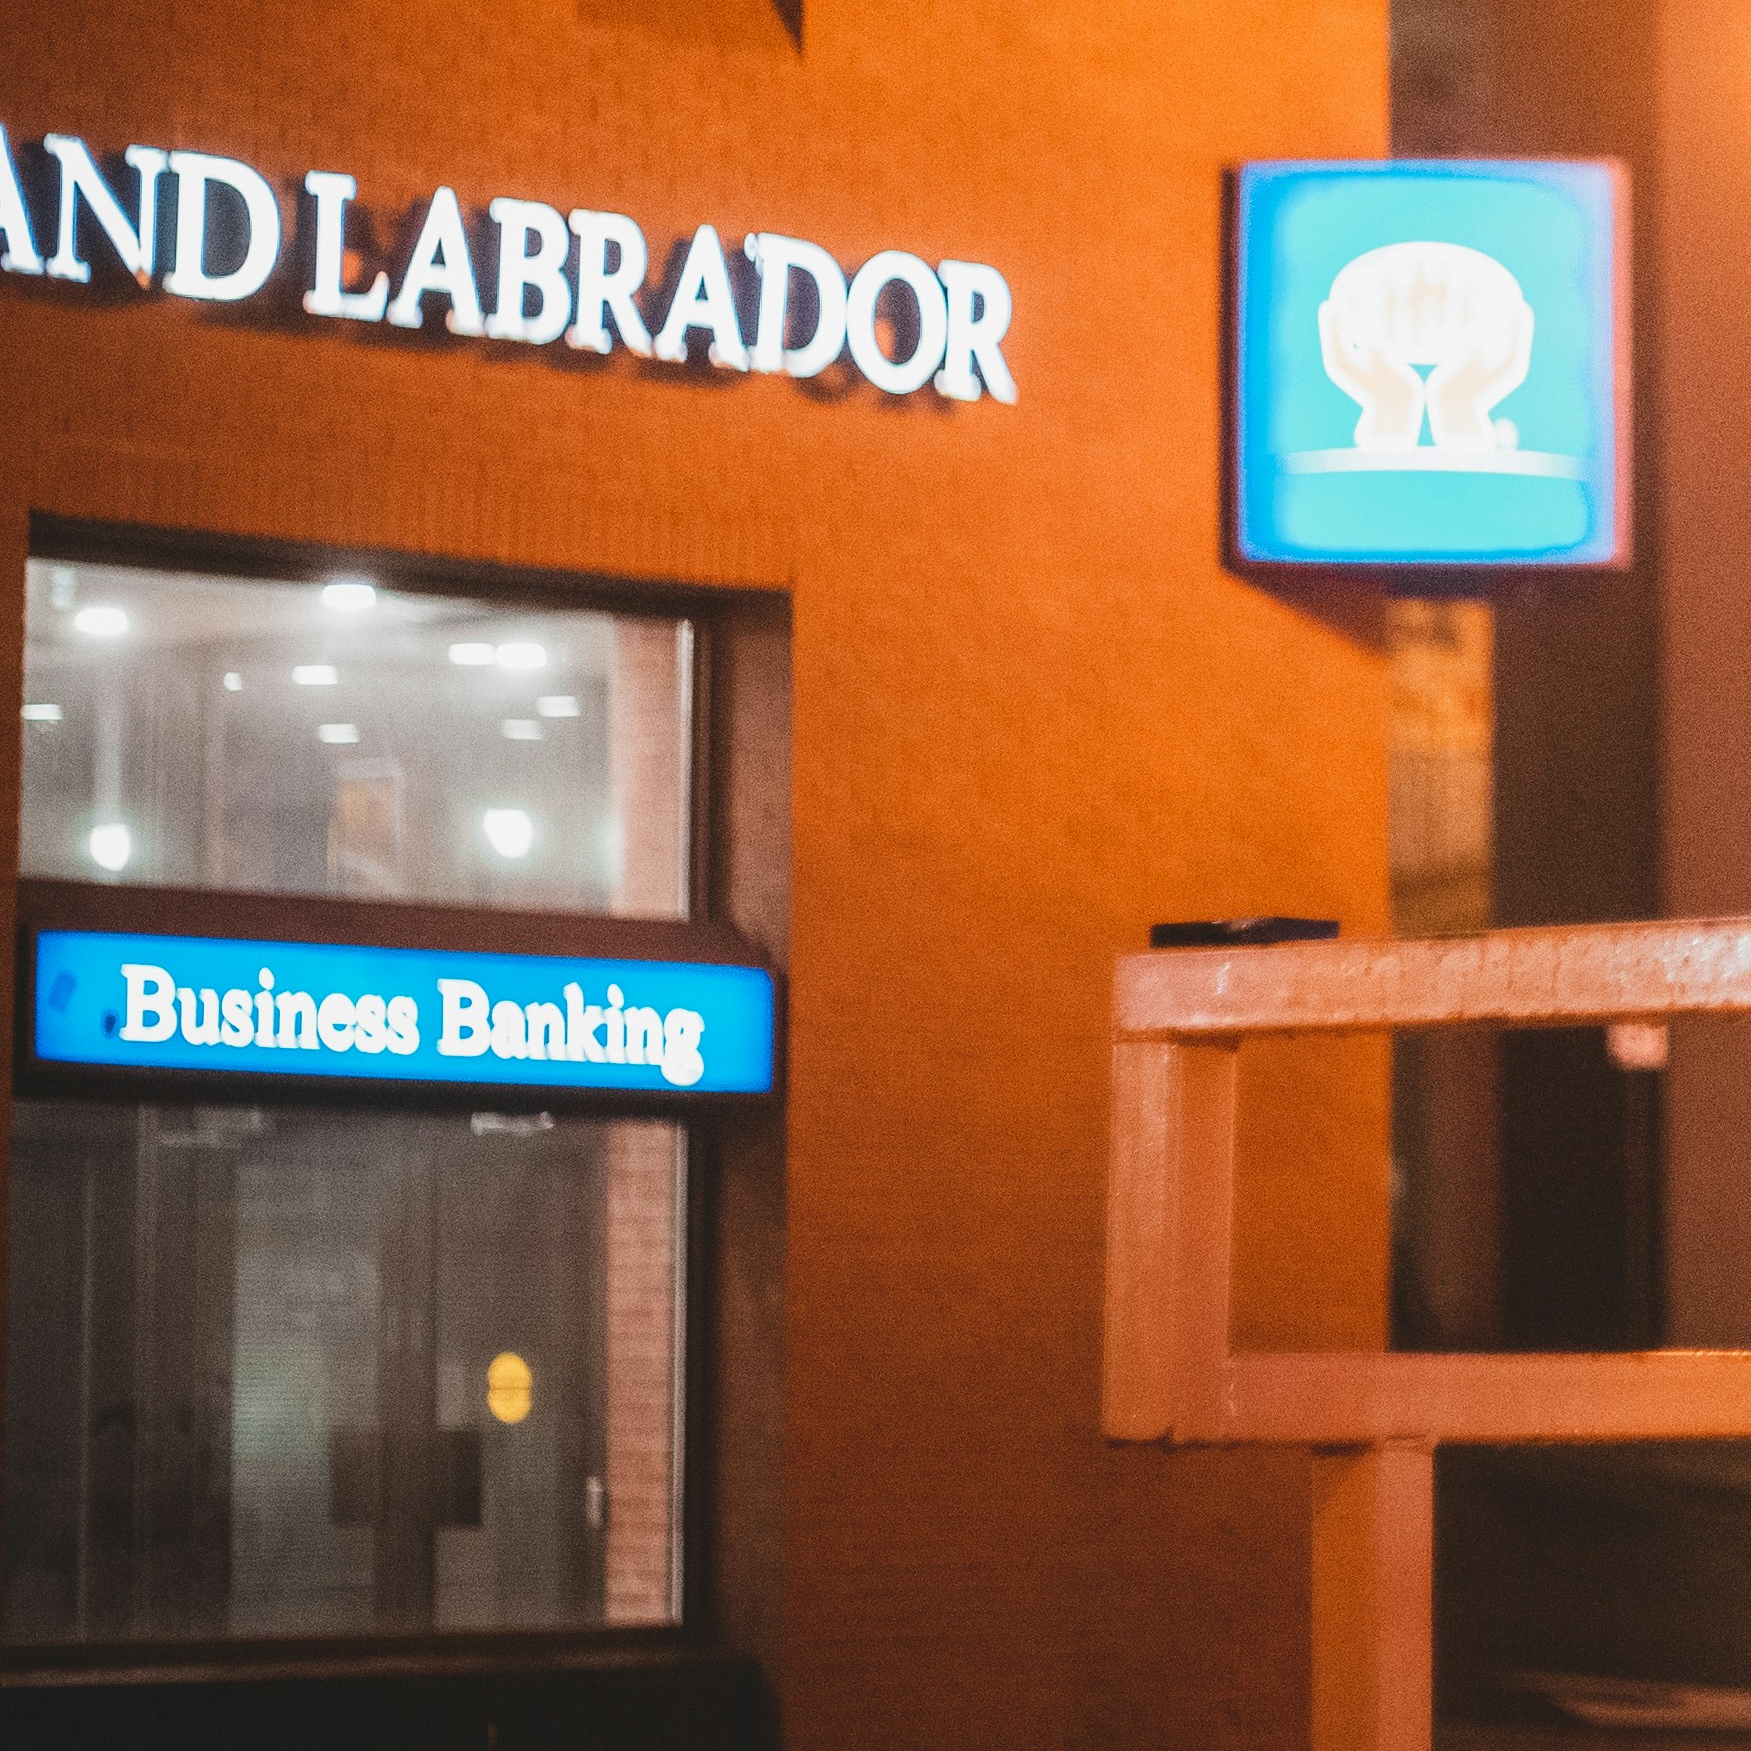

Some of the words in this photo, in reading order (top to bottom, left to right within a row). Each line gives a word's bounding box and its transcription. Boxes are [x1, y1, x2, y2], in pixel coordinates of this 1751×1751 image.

[304, 170, 1018, 405] LABRADOR
[120, 963, 420, 1056] Business
[436, 977, 705, 1087] Banking
